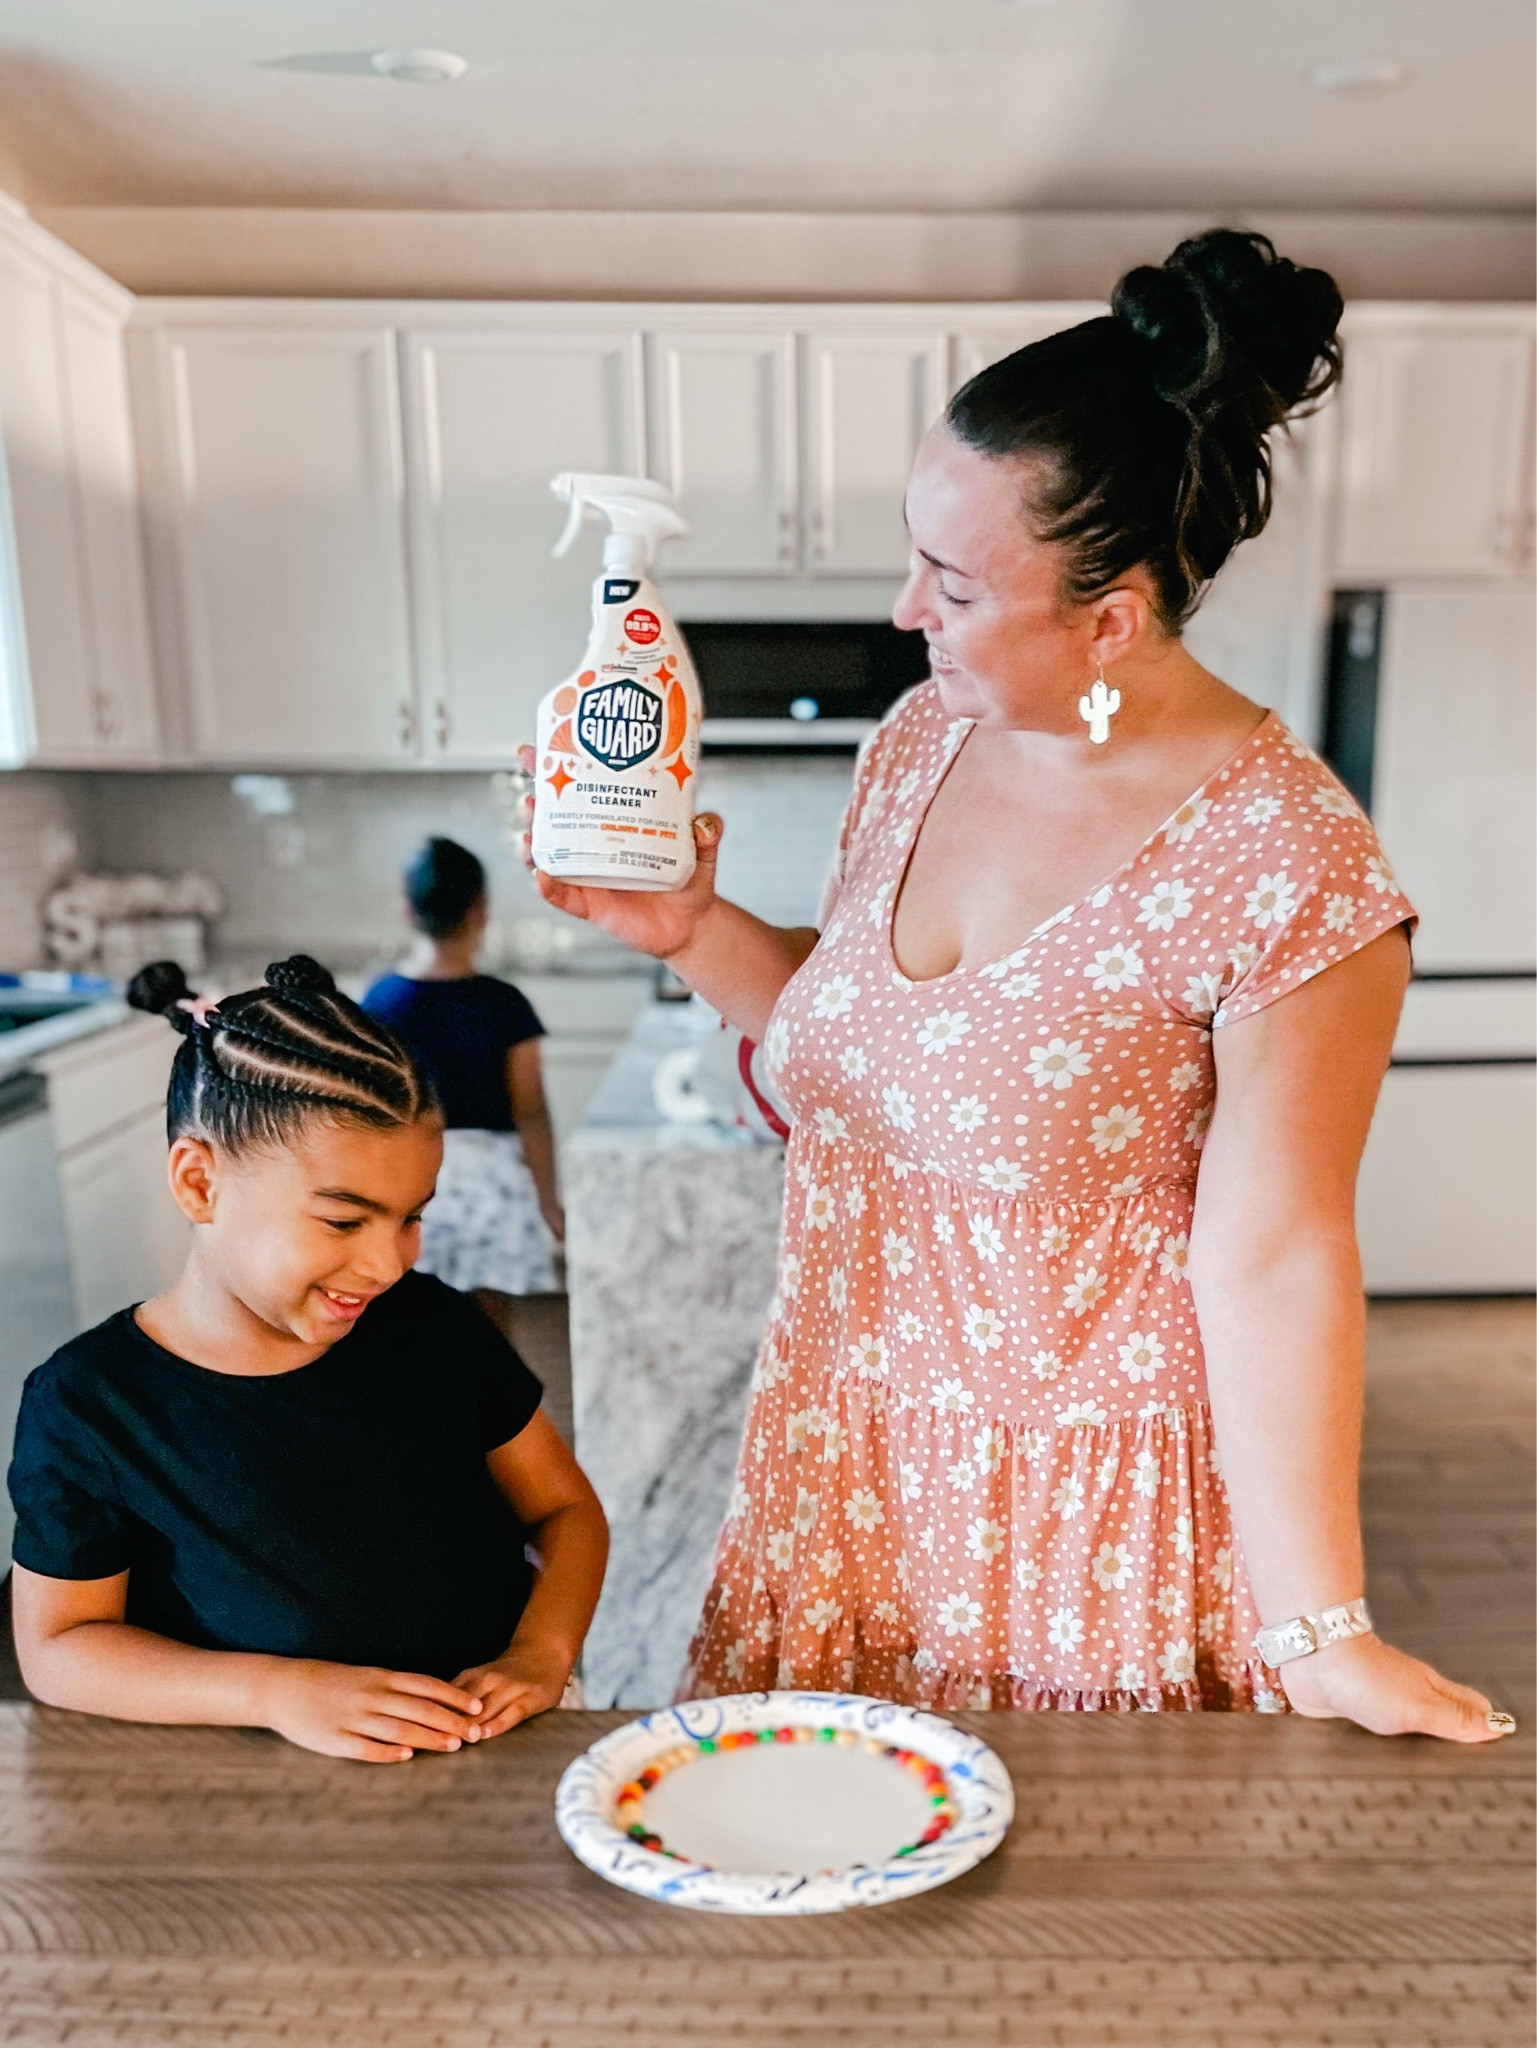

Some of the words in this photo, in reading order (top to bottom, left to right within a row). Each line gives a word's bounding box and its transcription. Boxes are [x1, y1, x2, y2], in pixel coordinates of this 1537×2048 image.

[583, 686, 659, 721] FAMILY
[580, 717, 657, 758] GUARD
[576, 783, 658, 798] DISINFECTANT
[591, 796, 642, 808] CLEANER
[549, 812, 585, 820] EXPERTLY
[586, 813, 636, 823] FORMULATED
[638, 817, 654, 826] FOR
[655, 819, 669, 828] USE
